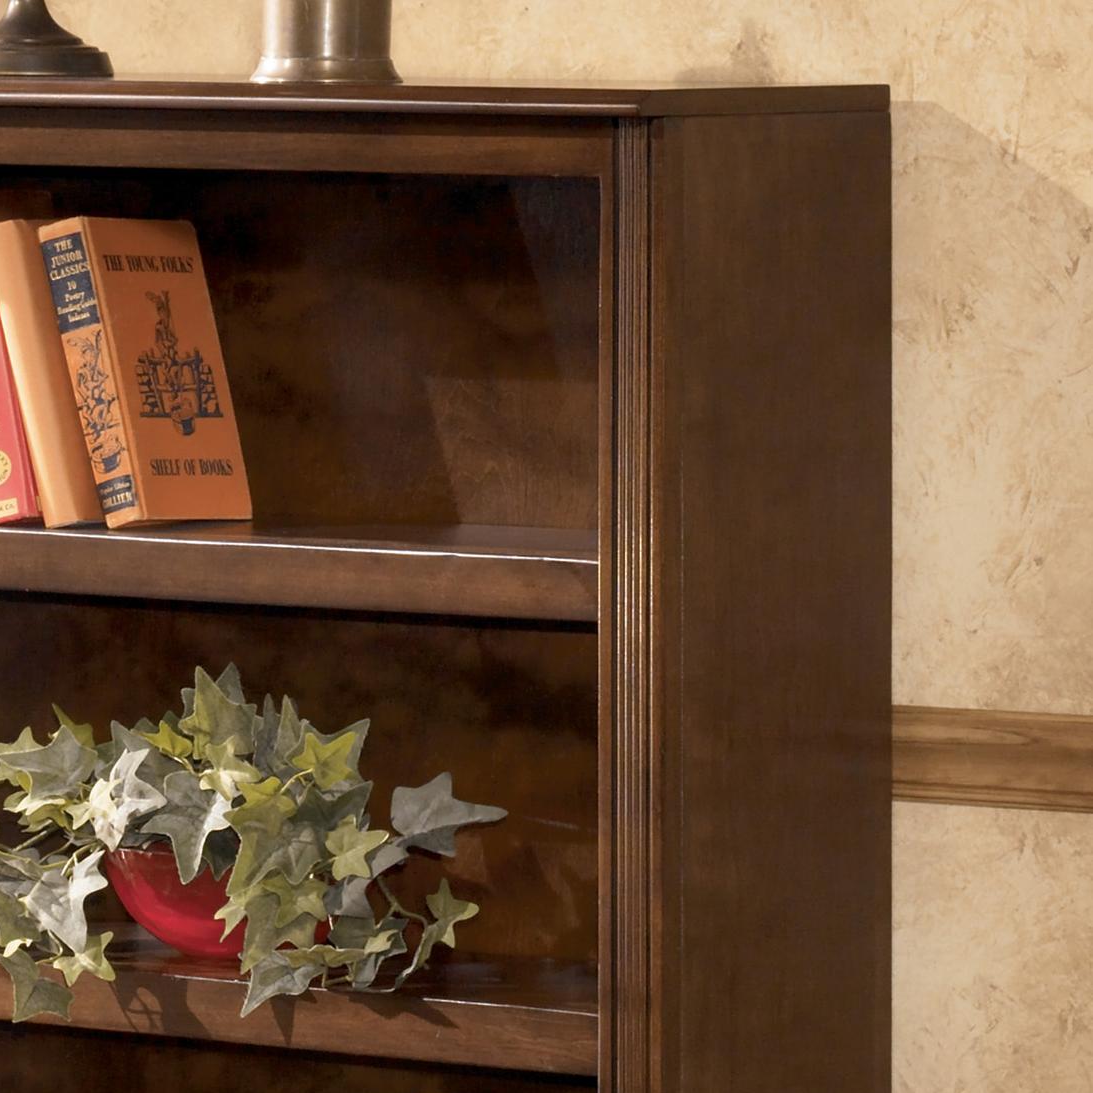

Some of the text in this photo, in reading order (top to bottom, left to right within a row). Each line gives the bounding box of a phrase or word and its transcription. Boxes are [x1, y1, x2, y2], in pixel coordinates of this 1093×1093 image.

[54, 239, 73, 252] THE
[51, 250, 83, 268] JUNIOR
[103, 255, 124, 271] THE
[159, 256, 194, 273] FOLKS
[50, 261, 91, 280] CLASSICS
[150, 458, 234, 477] SHELF OF BOOKS
[102, 491, 133, 509] COLLIER
